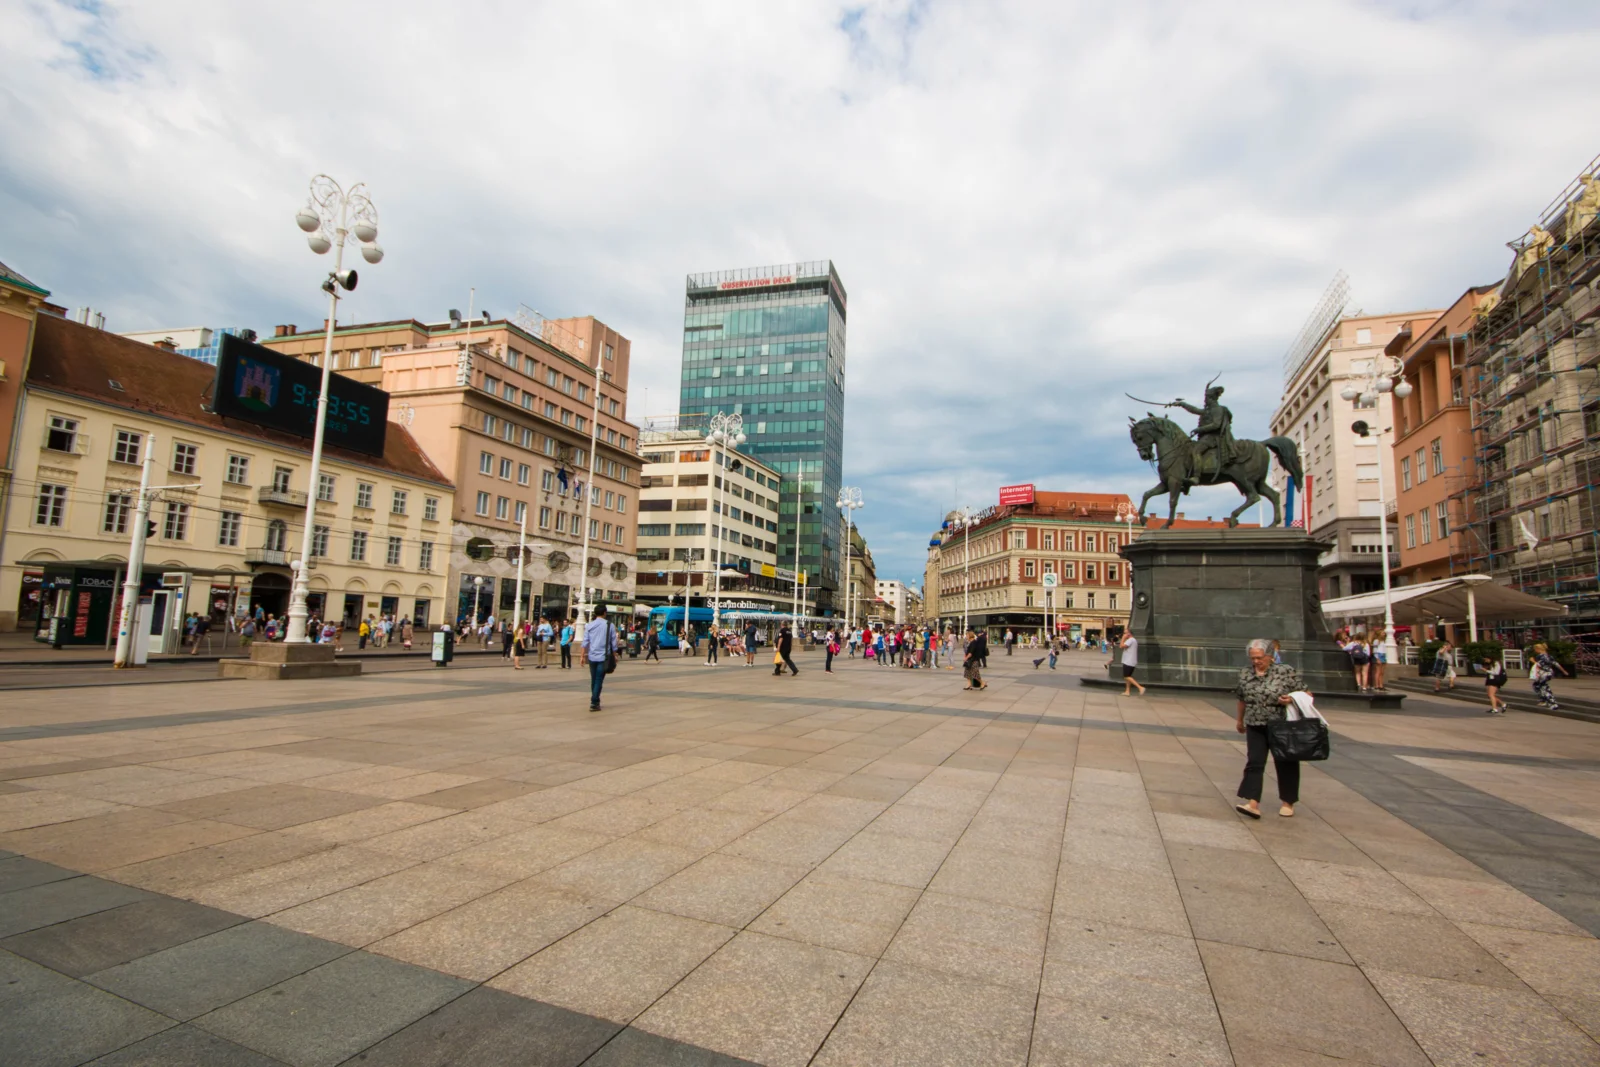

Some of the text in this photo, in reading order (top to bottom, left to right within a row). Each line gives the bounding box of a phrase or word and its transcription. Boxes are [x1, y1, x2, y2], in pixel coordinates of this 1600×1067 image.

[722, 276, 791, 289] OBSERVATION DECK
[1000, 486, 1031, 494] Internorm
[82, 577, 126, 586] TOBAC
[706, 598, 727, 609] Špca
